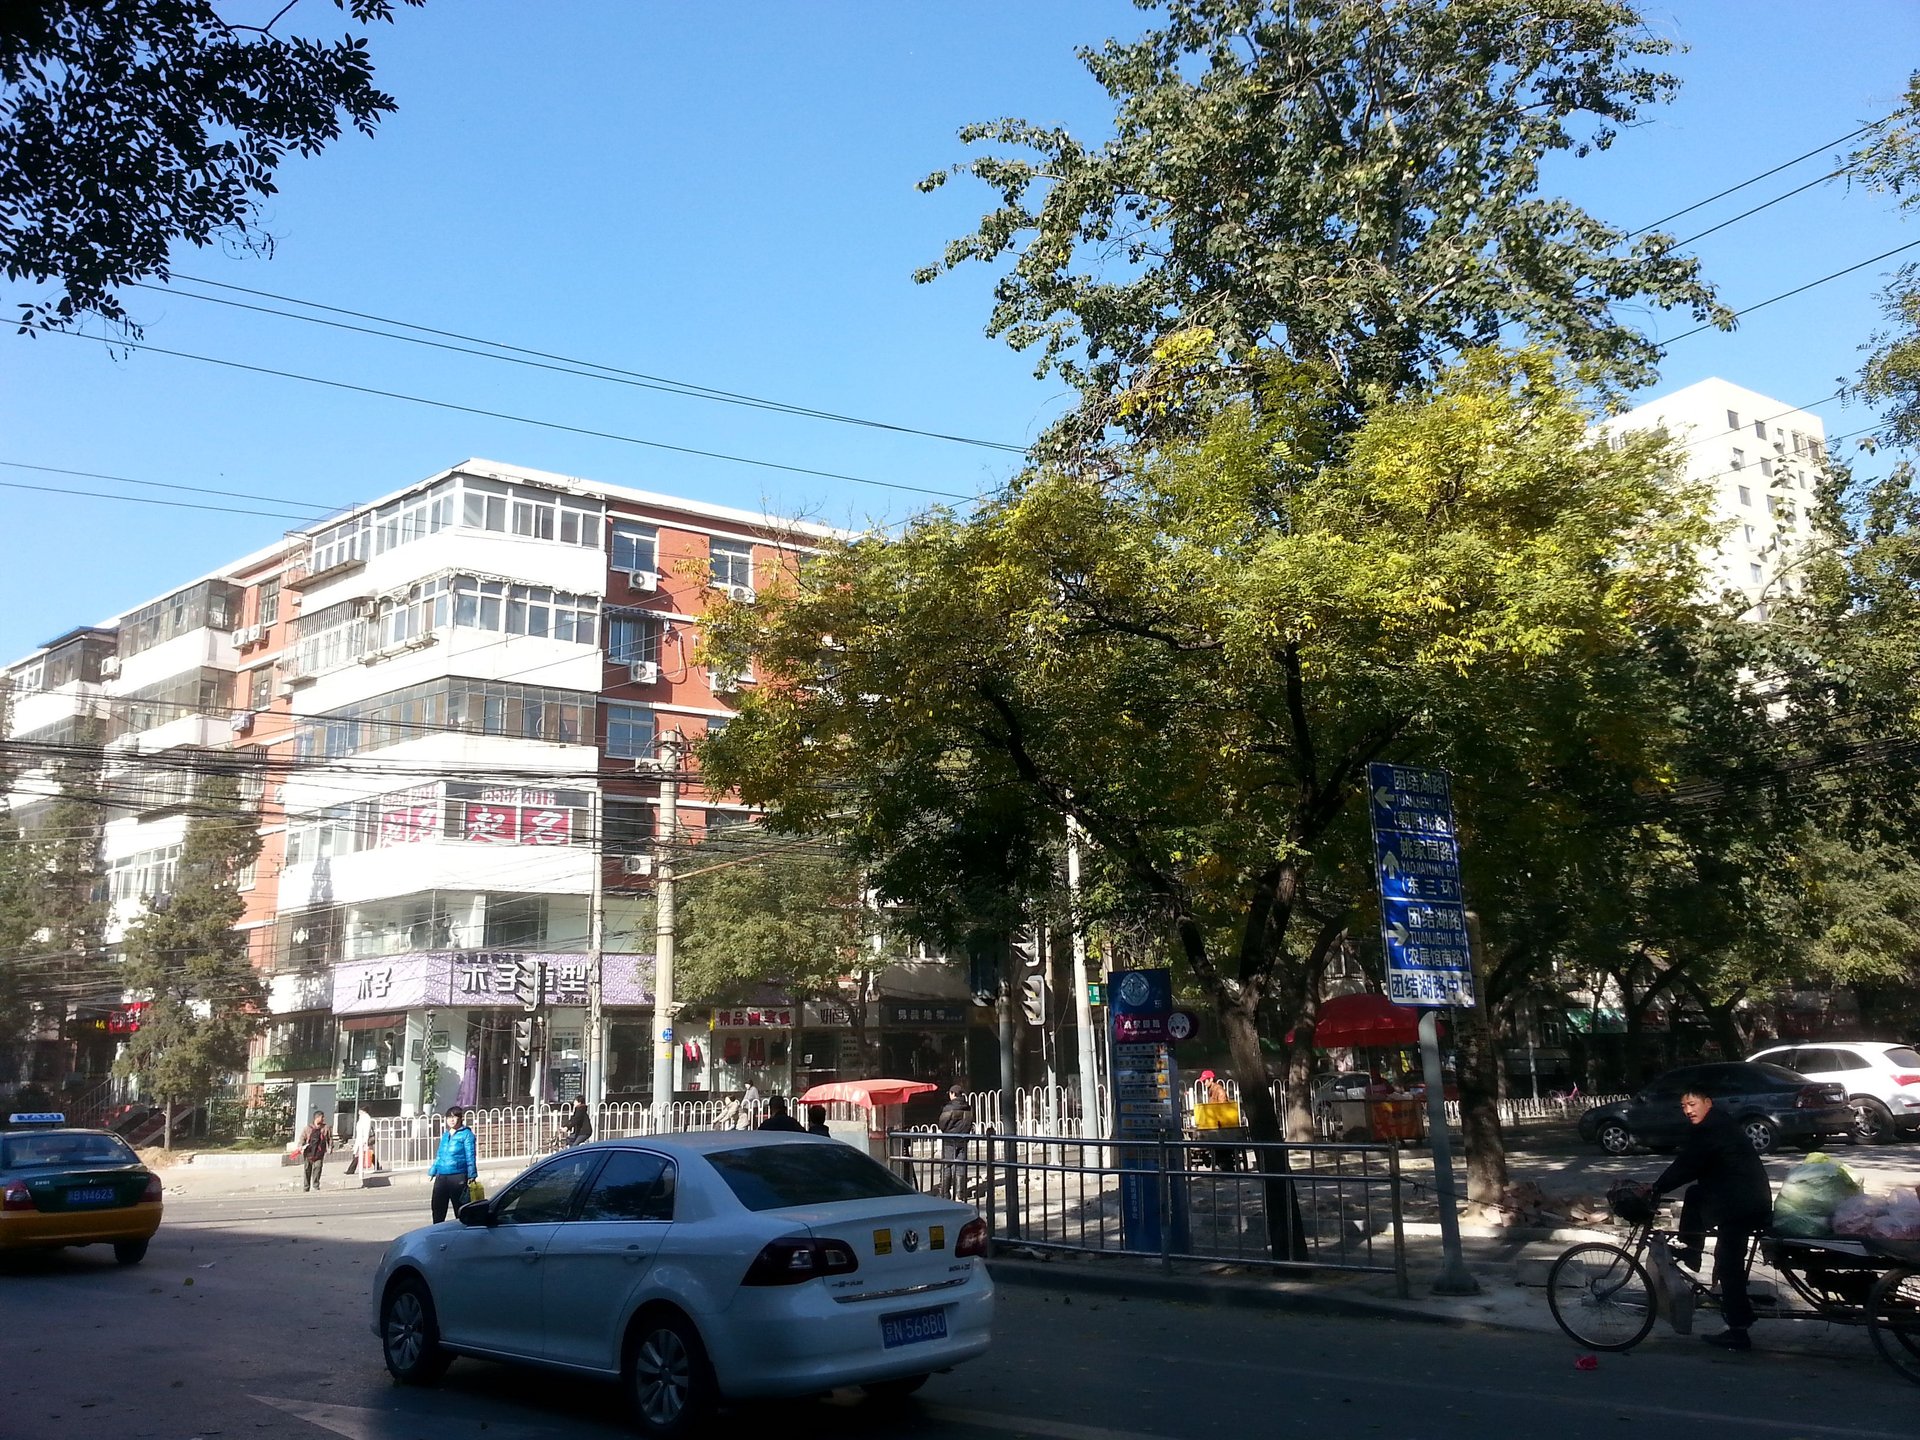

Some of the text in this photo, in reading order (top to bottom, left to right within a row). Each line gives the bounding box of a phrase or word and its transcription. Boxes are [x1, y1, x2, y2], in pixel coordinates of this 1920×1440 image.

[1393, 770, 1445, 795] 团结湖路
[1396, 794, 1435, 809] TUANJIEHU
[1400, 837, 1453, 861] 姚家园路
[1401, 861, 1444, 877] YAOJIAYUAN
[1408, 907, 1462, 930] 团结湖路
[1410, 931, 1465, 946] TUANJIEHU Rd
[1403, 946, 1467, 967] (农展馆南路)
